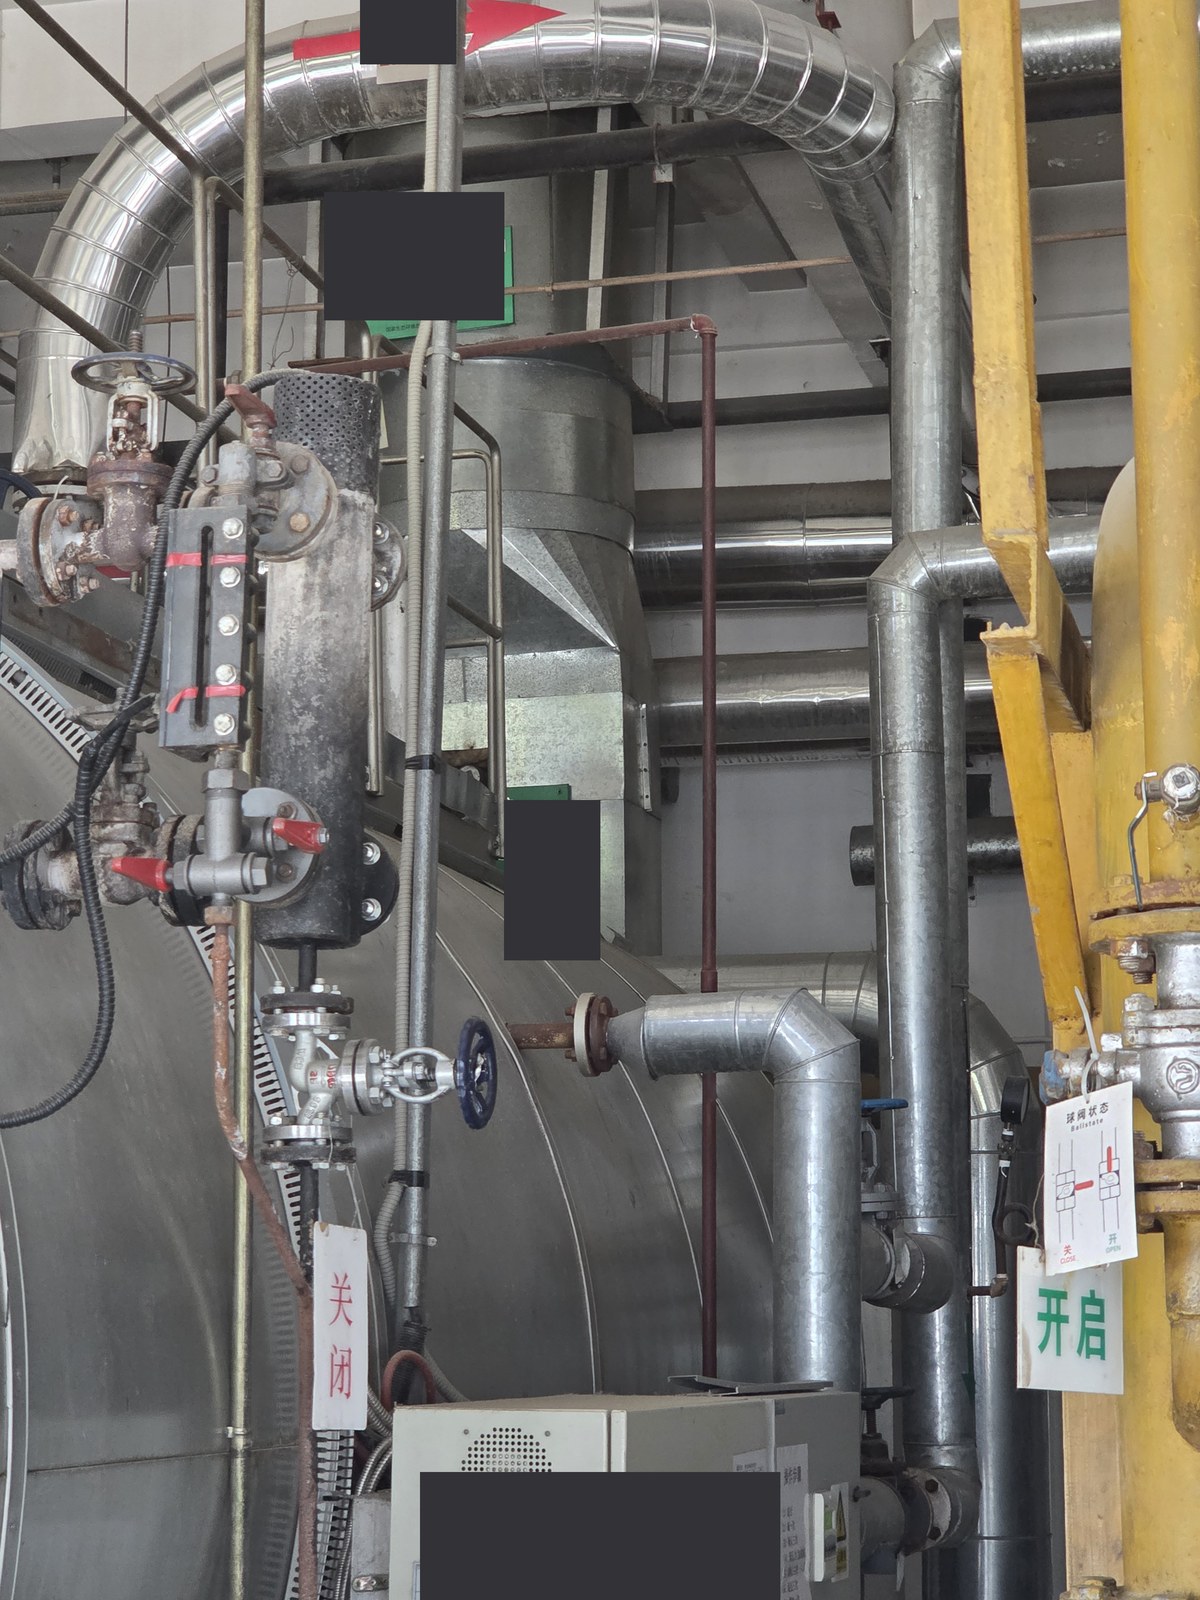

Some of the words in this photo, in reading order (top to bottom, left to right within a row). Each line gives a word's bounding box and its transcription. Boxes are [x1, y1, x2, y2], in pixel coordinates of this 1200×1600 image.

[1066, 1102, 1109, 1124] 球阀状态
[1109, 1233, 1117, 1245] 开
[1063, 1244, 1072, 1256] 关
[1105, 1245, 1121, 1254] OPEN
[1060, 1255, 1077, 1264] CLOSE
[1037, 1287, 1107, 1361] 开启
[328, 1271, 354, 1400] 关闭
